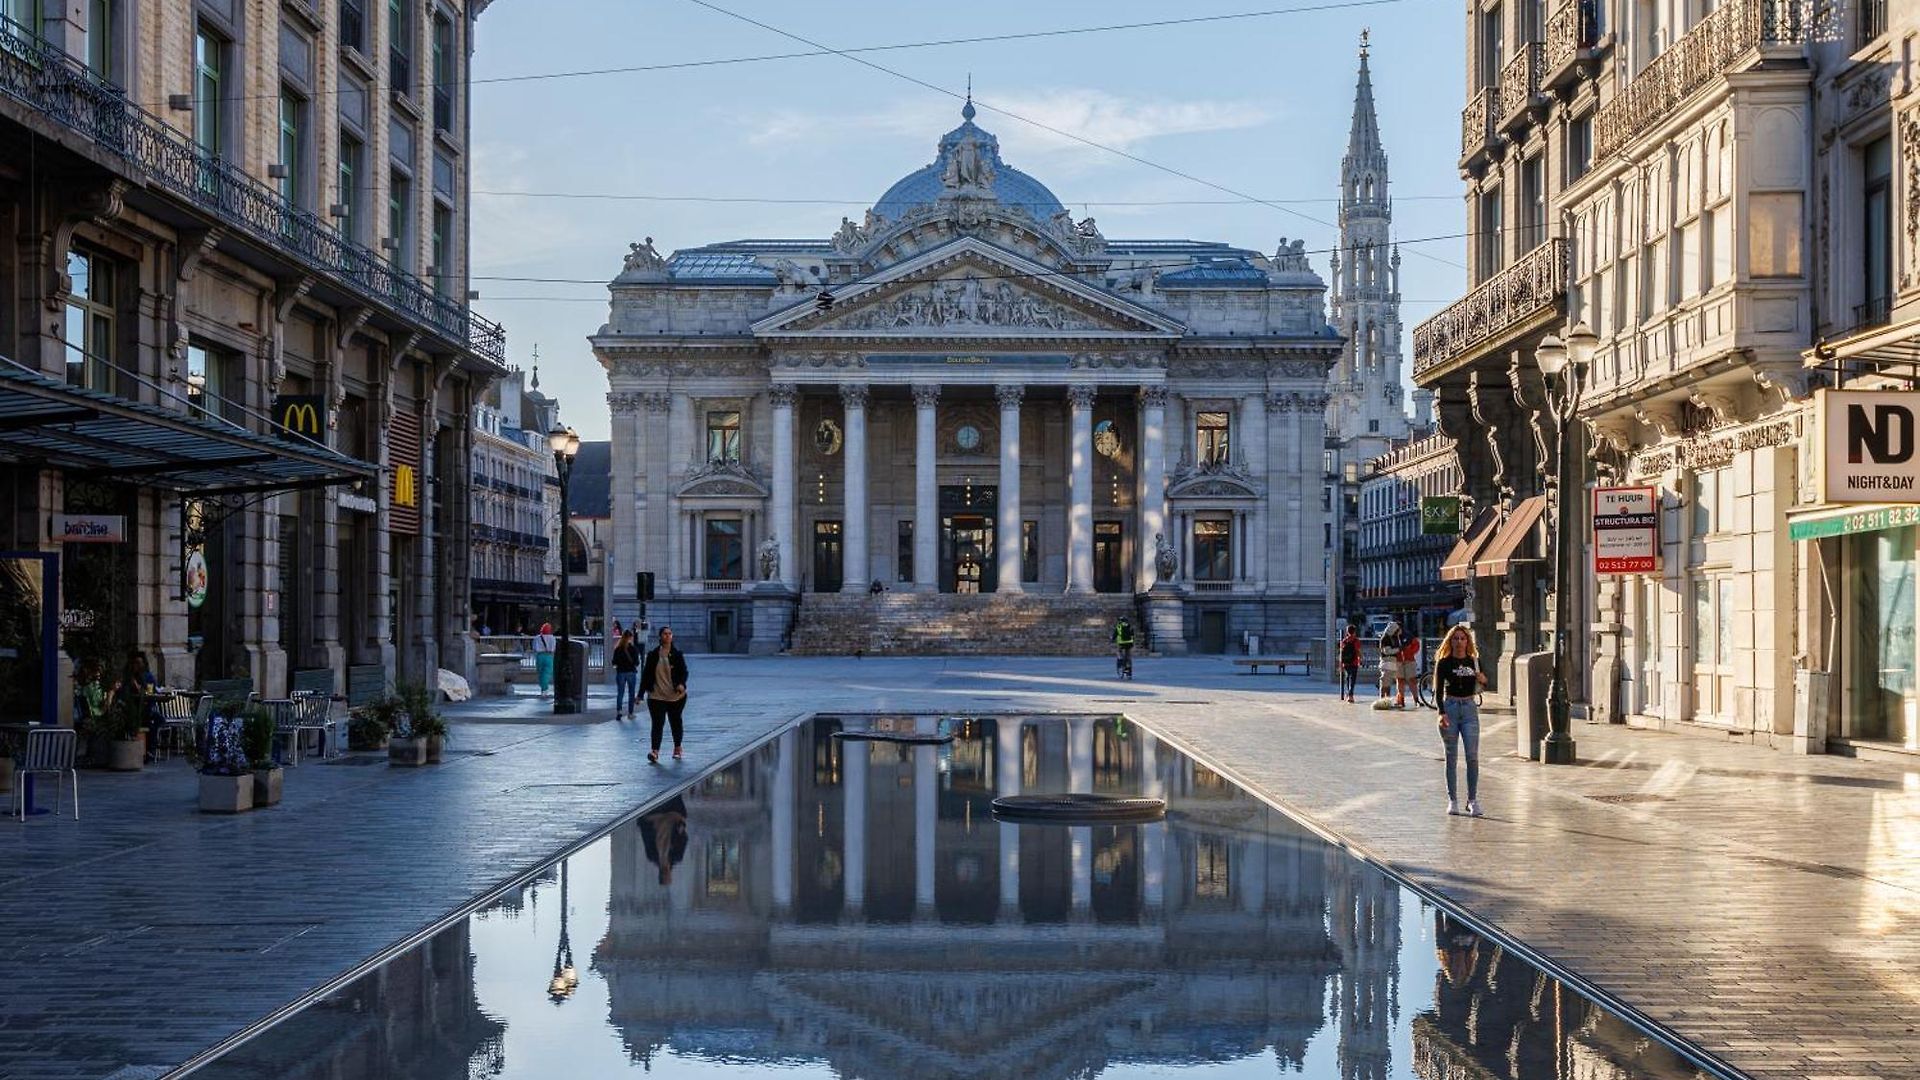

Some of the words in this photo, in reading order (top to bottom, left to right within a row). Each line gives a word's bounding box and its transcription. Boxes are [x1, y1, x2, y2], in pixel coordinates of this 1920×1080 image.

[1847, 404, 1914, 464] ND
[1847, 475, 1915, 490] NIGHT&DAY
[1618, 494, 1643, 503] HUUR
[1852, 515, 1865, 530] 02
[1868, 512, 1884, 528] 511
[1904, 506, 1920, 522] 32
[1599, 562, 1610, 570] 02
[1611, 561, 1626, 569] 513
[1641, 560, 1652, 568] 00
